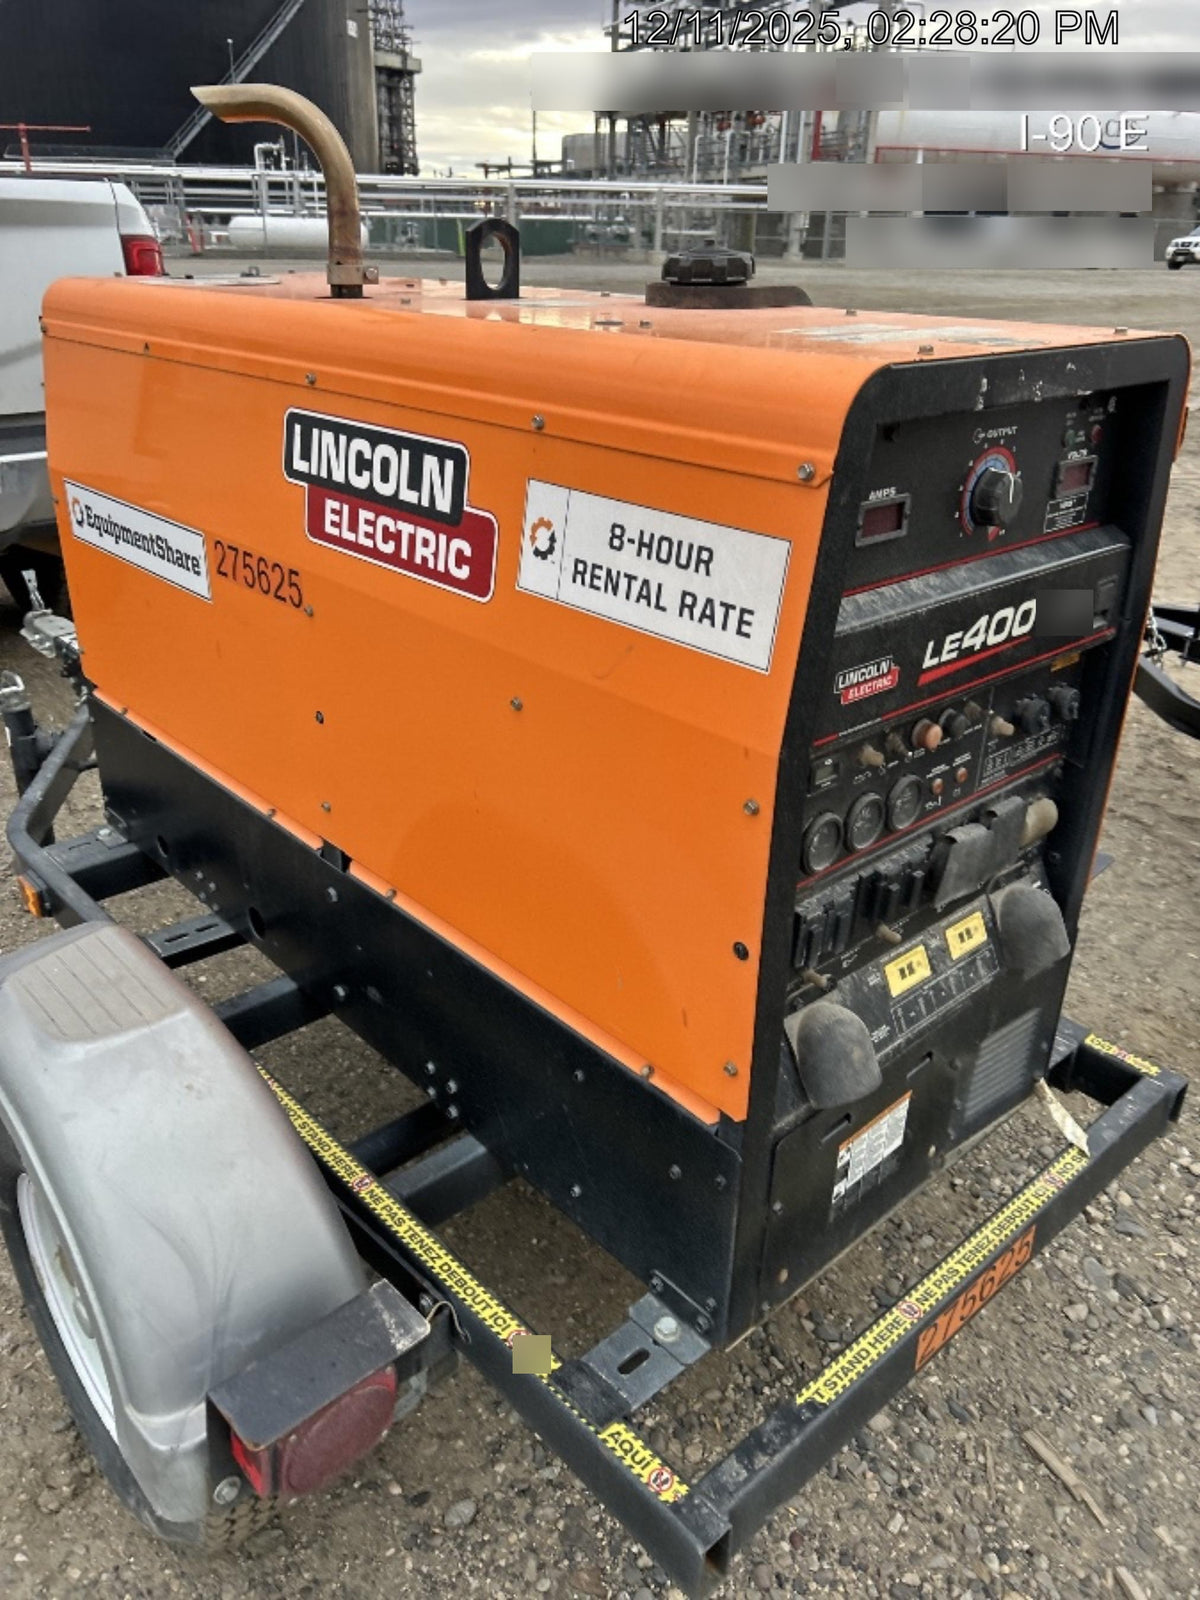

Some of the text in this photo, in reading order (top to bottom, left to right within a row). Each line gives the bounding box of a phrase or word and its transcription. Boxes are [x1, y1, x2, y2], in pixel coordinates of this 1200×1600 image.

[293, 423, 455, 515] LINCOLN
[869, 486, 897, 501] AMPS
[84, 504, 201, 577] EquipmentShare
[214, 540, 303, 609] 275625
[324, 497, 472, 580] ELECTRIC
[608, 522, 715, 578] 8-HOUR
[572, 558, 756, 640] RENTAL RATE
[922, 599, 1037, 669] LE400
[838, 659, 890, 689] LINCOLN
[848, 675, 893, 700] ELECTRIC
[367, 1189, 512, 1332] NE PAS TENEZ DEBOUT ICI
[915, 1287, 937, 1306] NE
[934, 1265, 961, 1289] PAS
[958, 1233, 994, 1268] TENEZ
[990, 1198, 1035, 1237] DEBOUT
[916, 1236, 1032, 1367] 275625
[823, 1314, 907, 1391] STAND HERE
